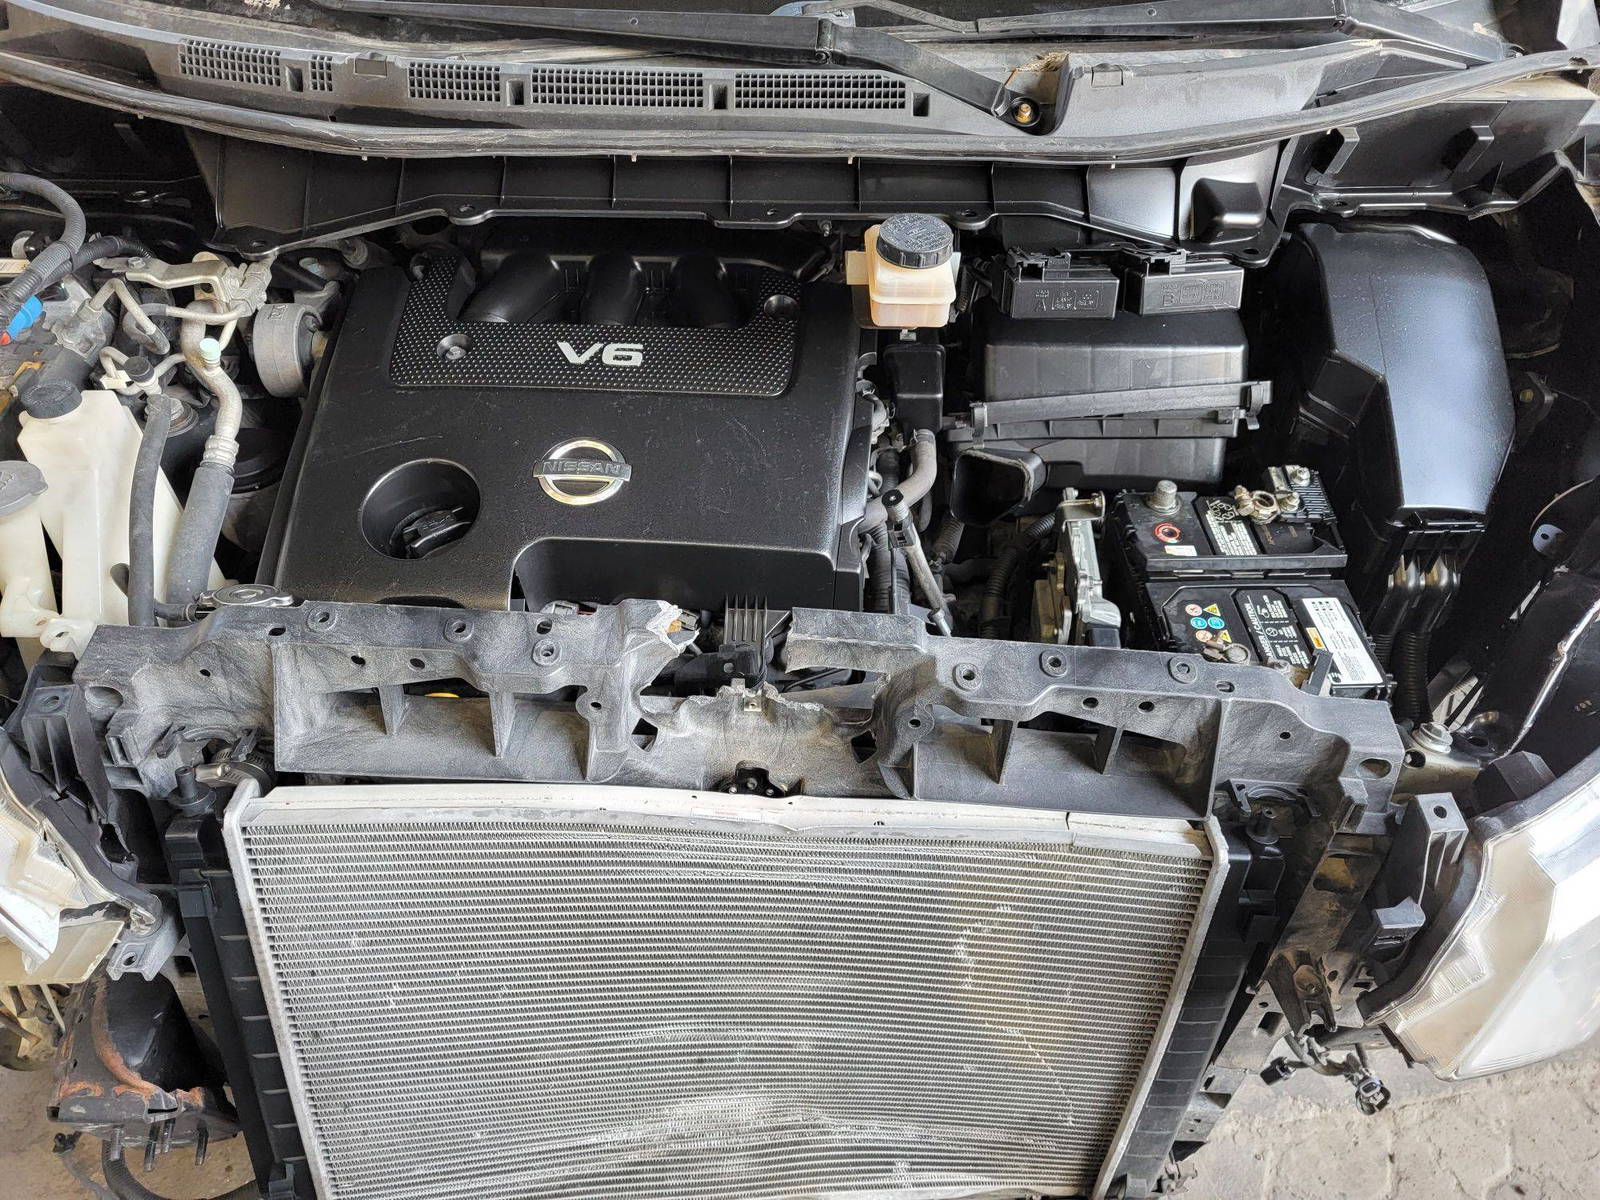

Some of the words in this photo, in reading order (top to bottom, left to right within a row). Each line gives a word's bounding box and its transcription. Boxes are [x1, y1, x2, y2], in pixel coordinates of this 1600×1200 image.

[556, 340, 644, 367] V6
[542, 460, 621, 475] NISSAN
[1243, 602, 1262, 631] CAUTION
[1258, 635, 1275, 660] ANGER
